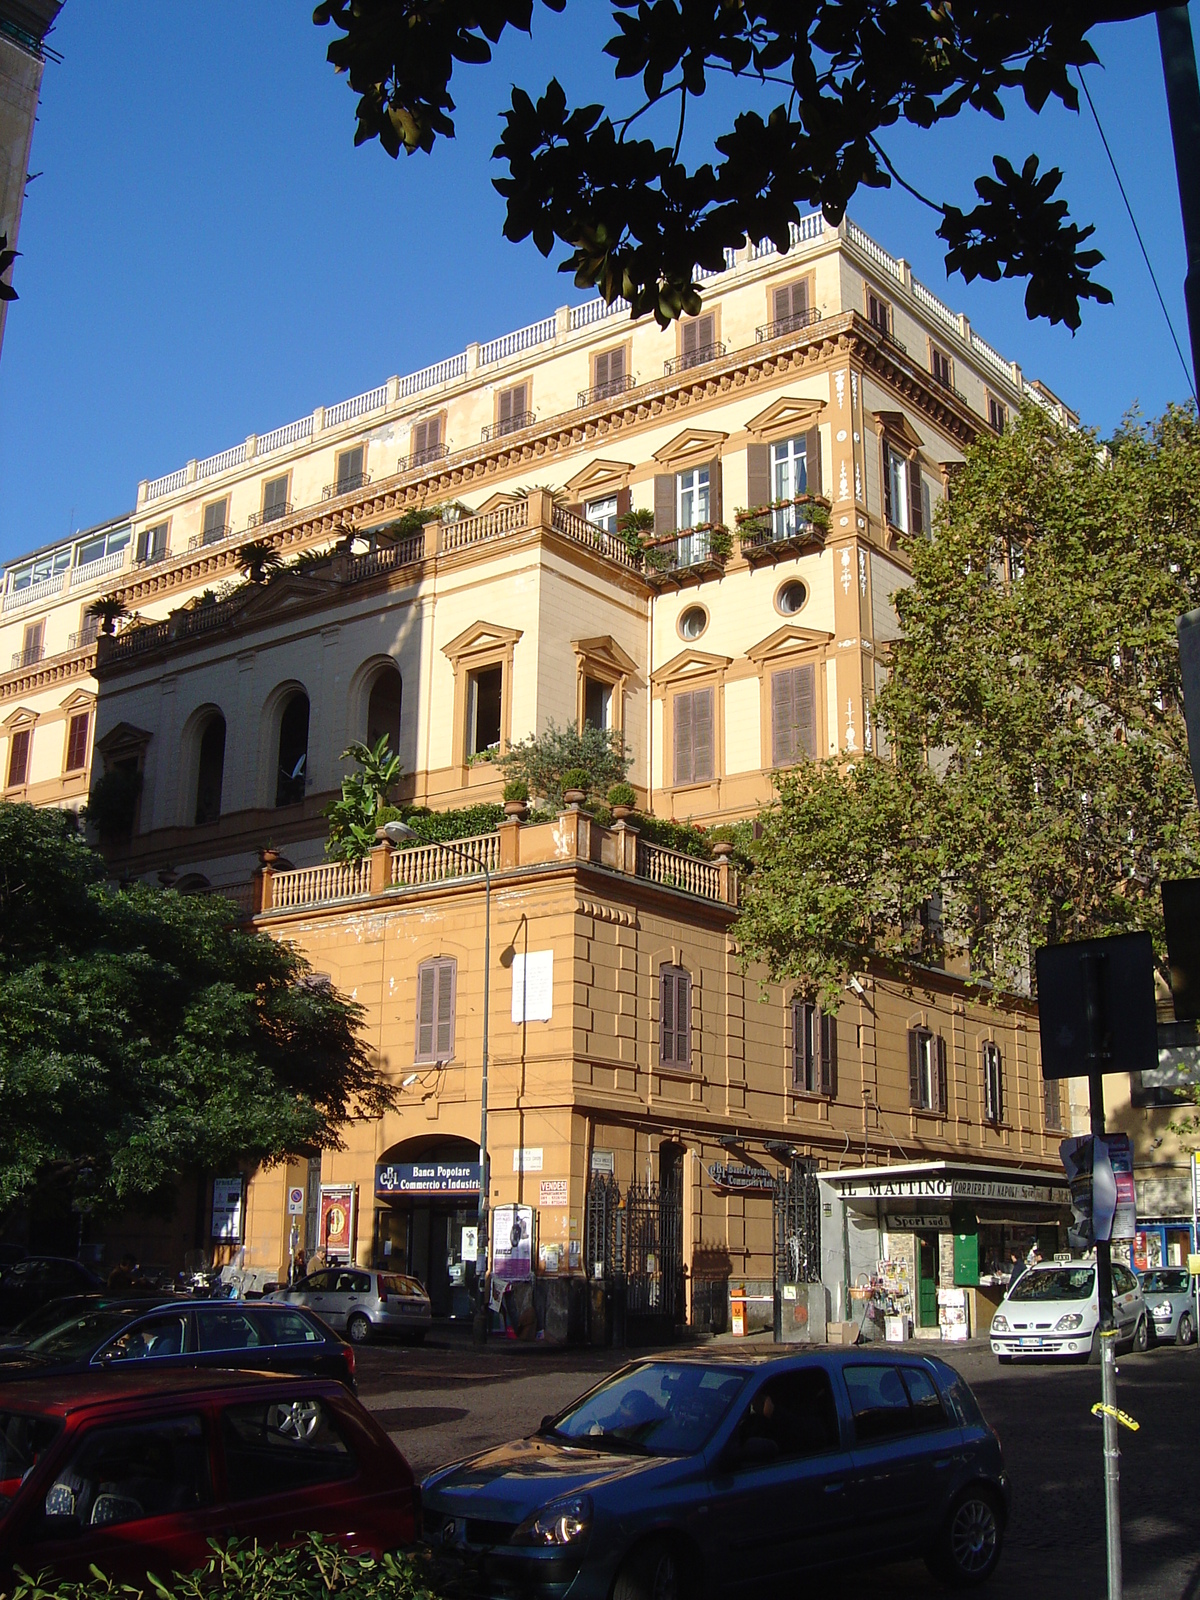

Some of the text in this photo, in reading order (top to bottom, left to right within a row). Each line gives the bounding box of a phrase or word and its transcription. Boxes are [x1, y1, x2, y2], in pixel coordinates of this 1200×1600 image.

[412, 1165, 471, 1179] Banca Popolare
[400, 1179, 440, 1190] Commercio
[441, 1181, 447, 1189] e
[541, 1180, 567, 1191] VENDESI
[840, 1179, 947, 1196] IL MATTINO
[954, 1180, 986, 1196] CORRIERE
[987, 1183, 995, 1197] DI
[997, 1184, 1018, 1198] NAPOLI
[894, 1216, 925, 1228] Sport
